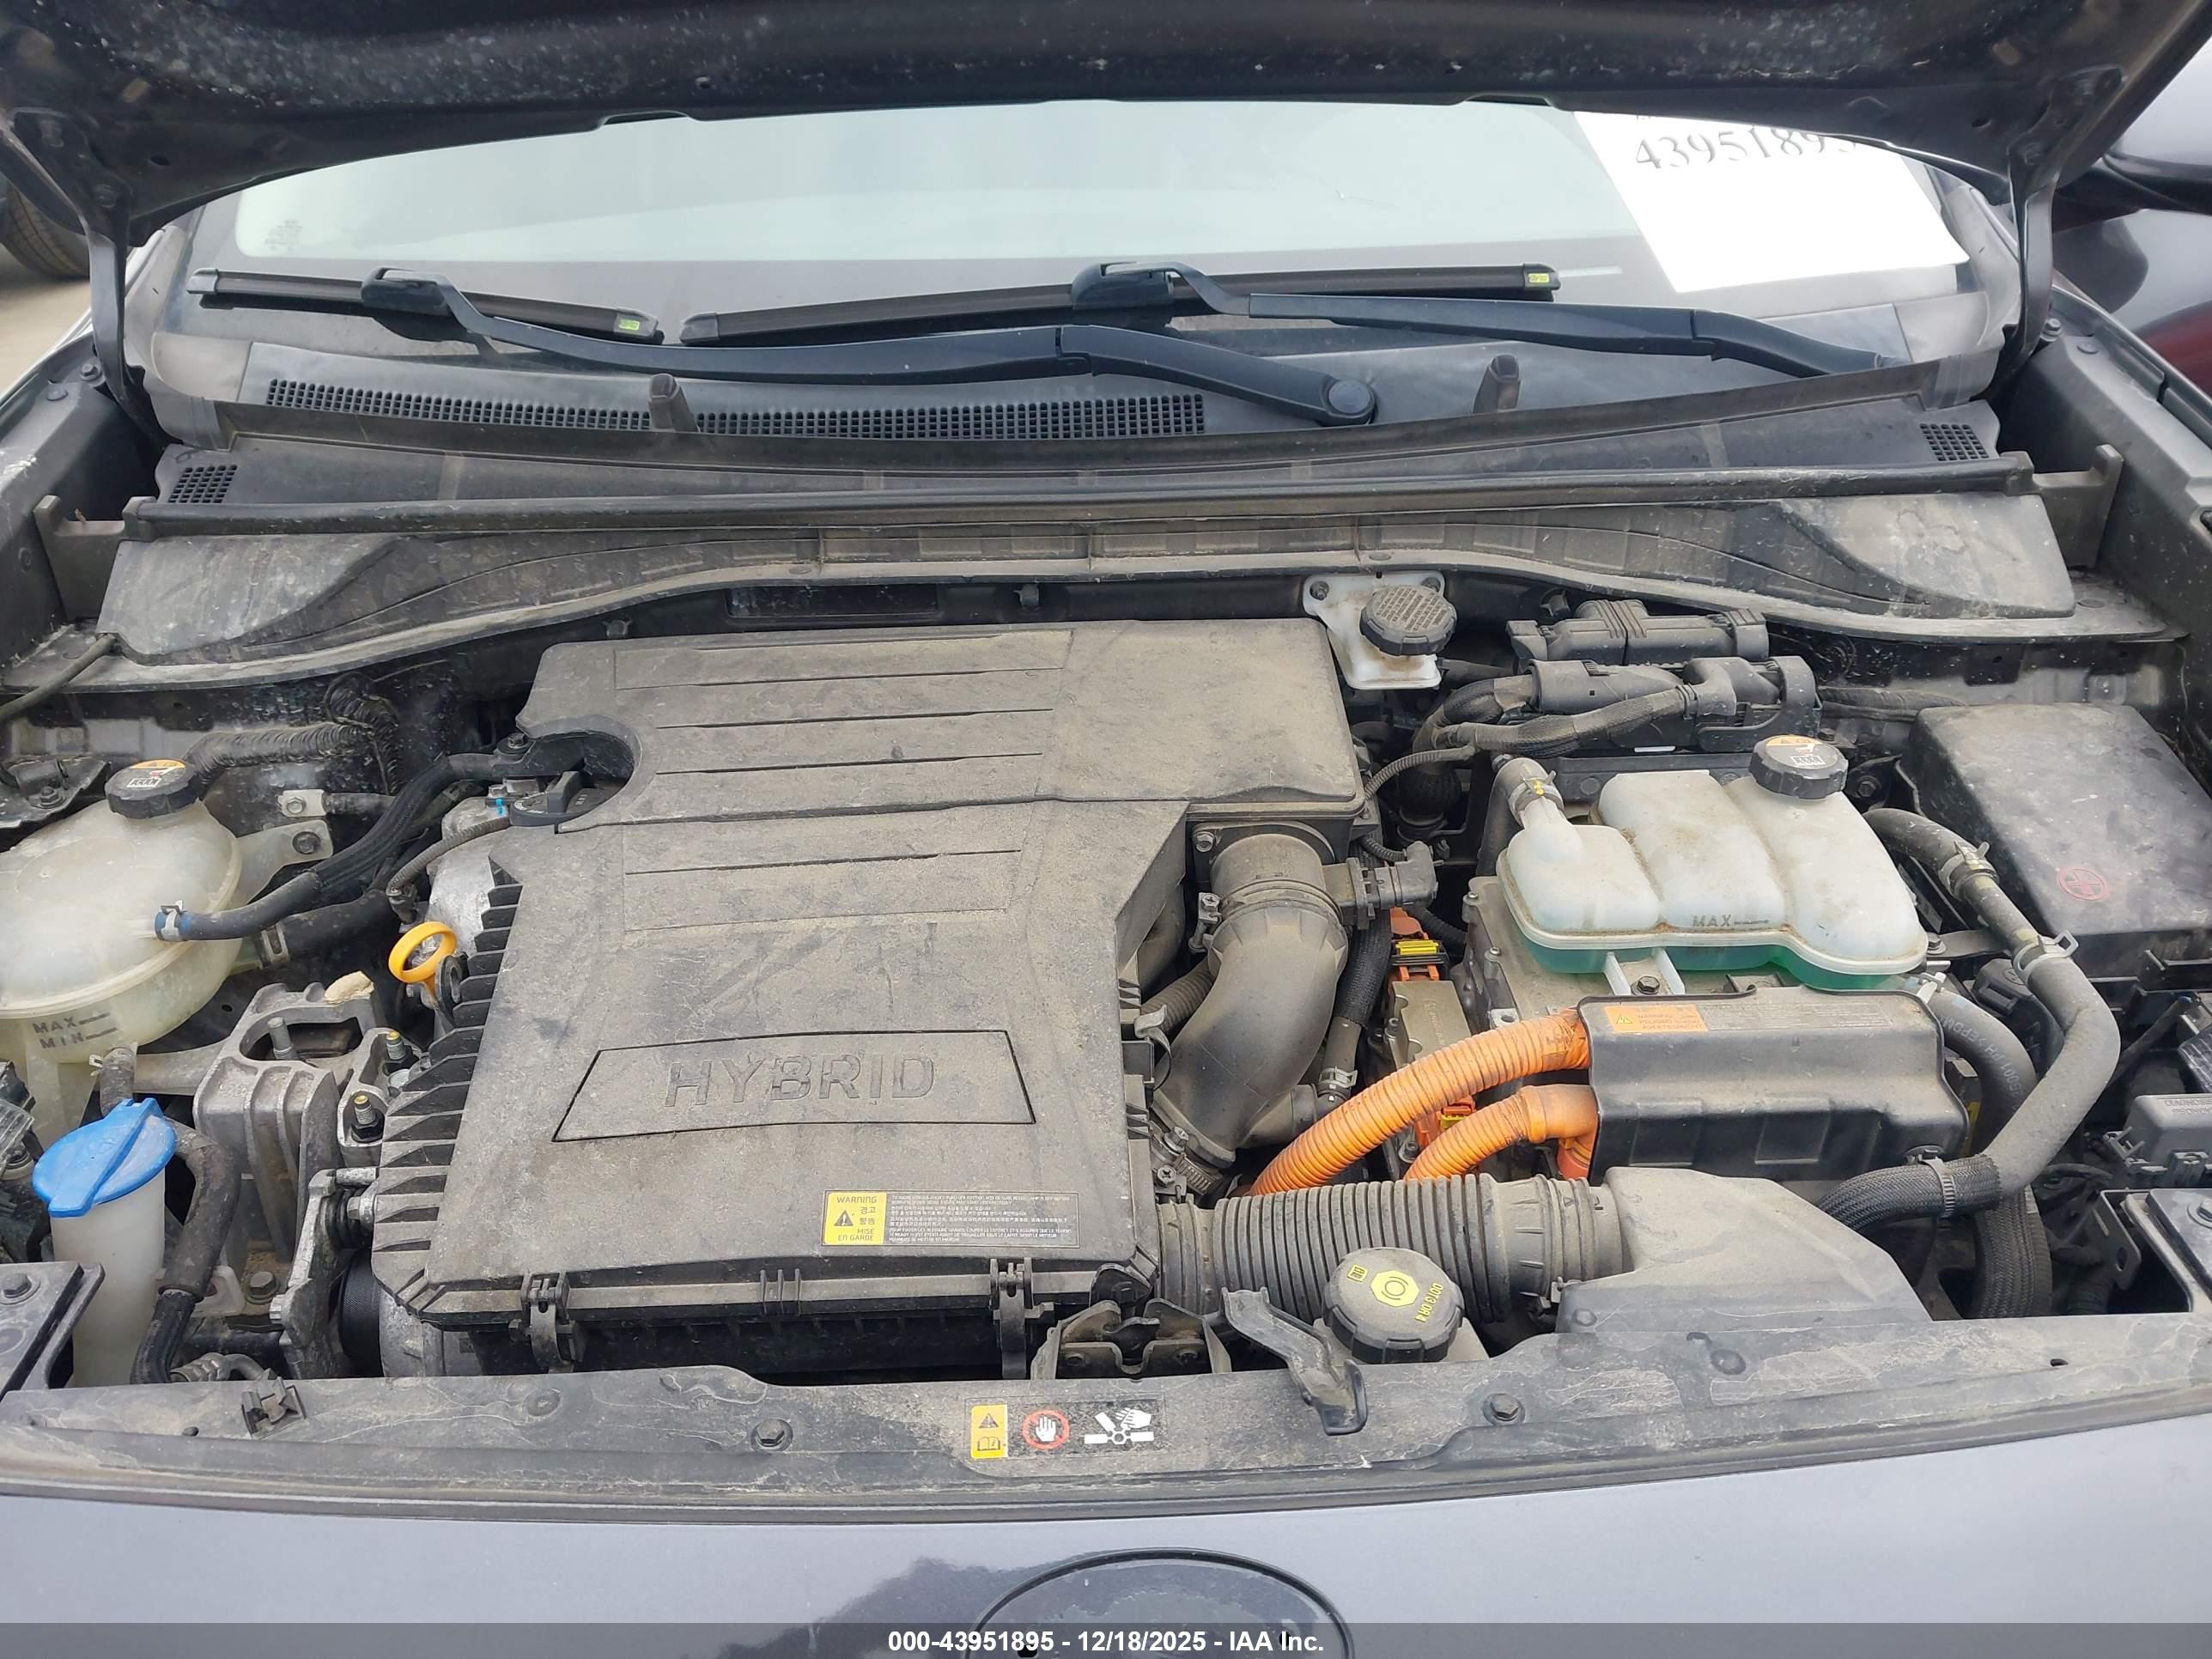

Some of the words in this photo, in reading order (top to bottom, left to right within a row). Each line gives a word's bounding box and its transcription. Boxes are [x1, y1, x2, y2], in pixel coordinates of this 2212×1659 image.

[1692, 914, 1732, 927] MAX
[32, 1017, 77, 1034] MAX
[40, 1032, 84, 1048] MIN
[664, 1053, 935, 1108] HYBRID
